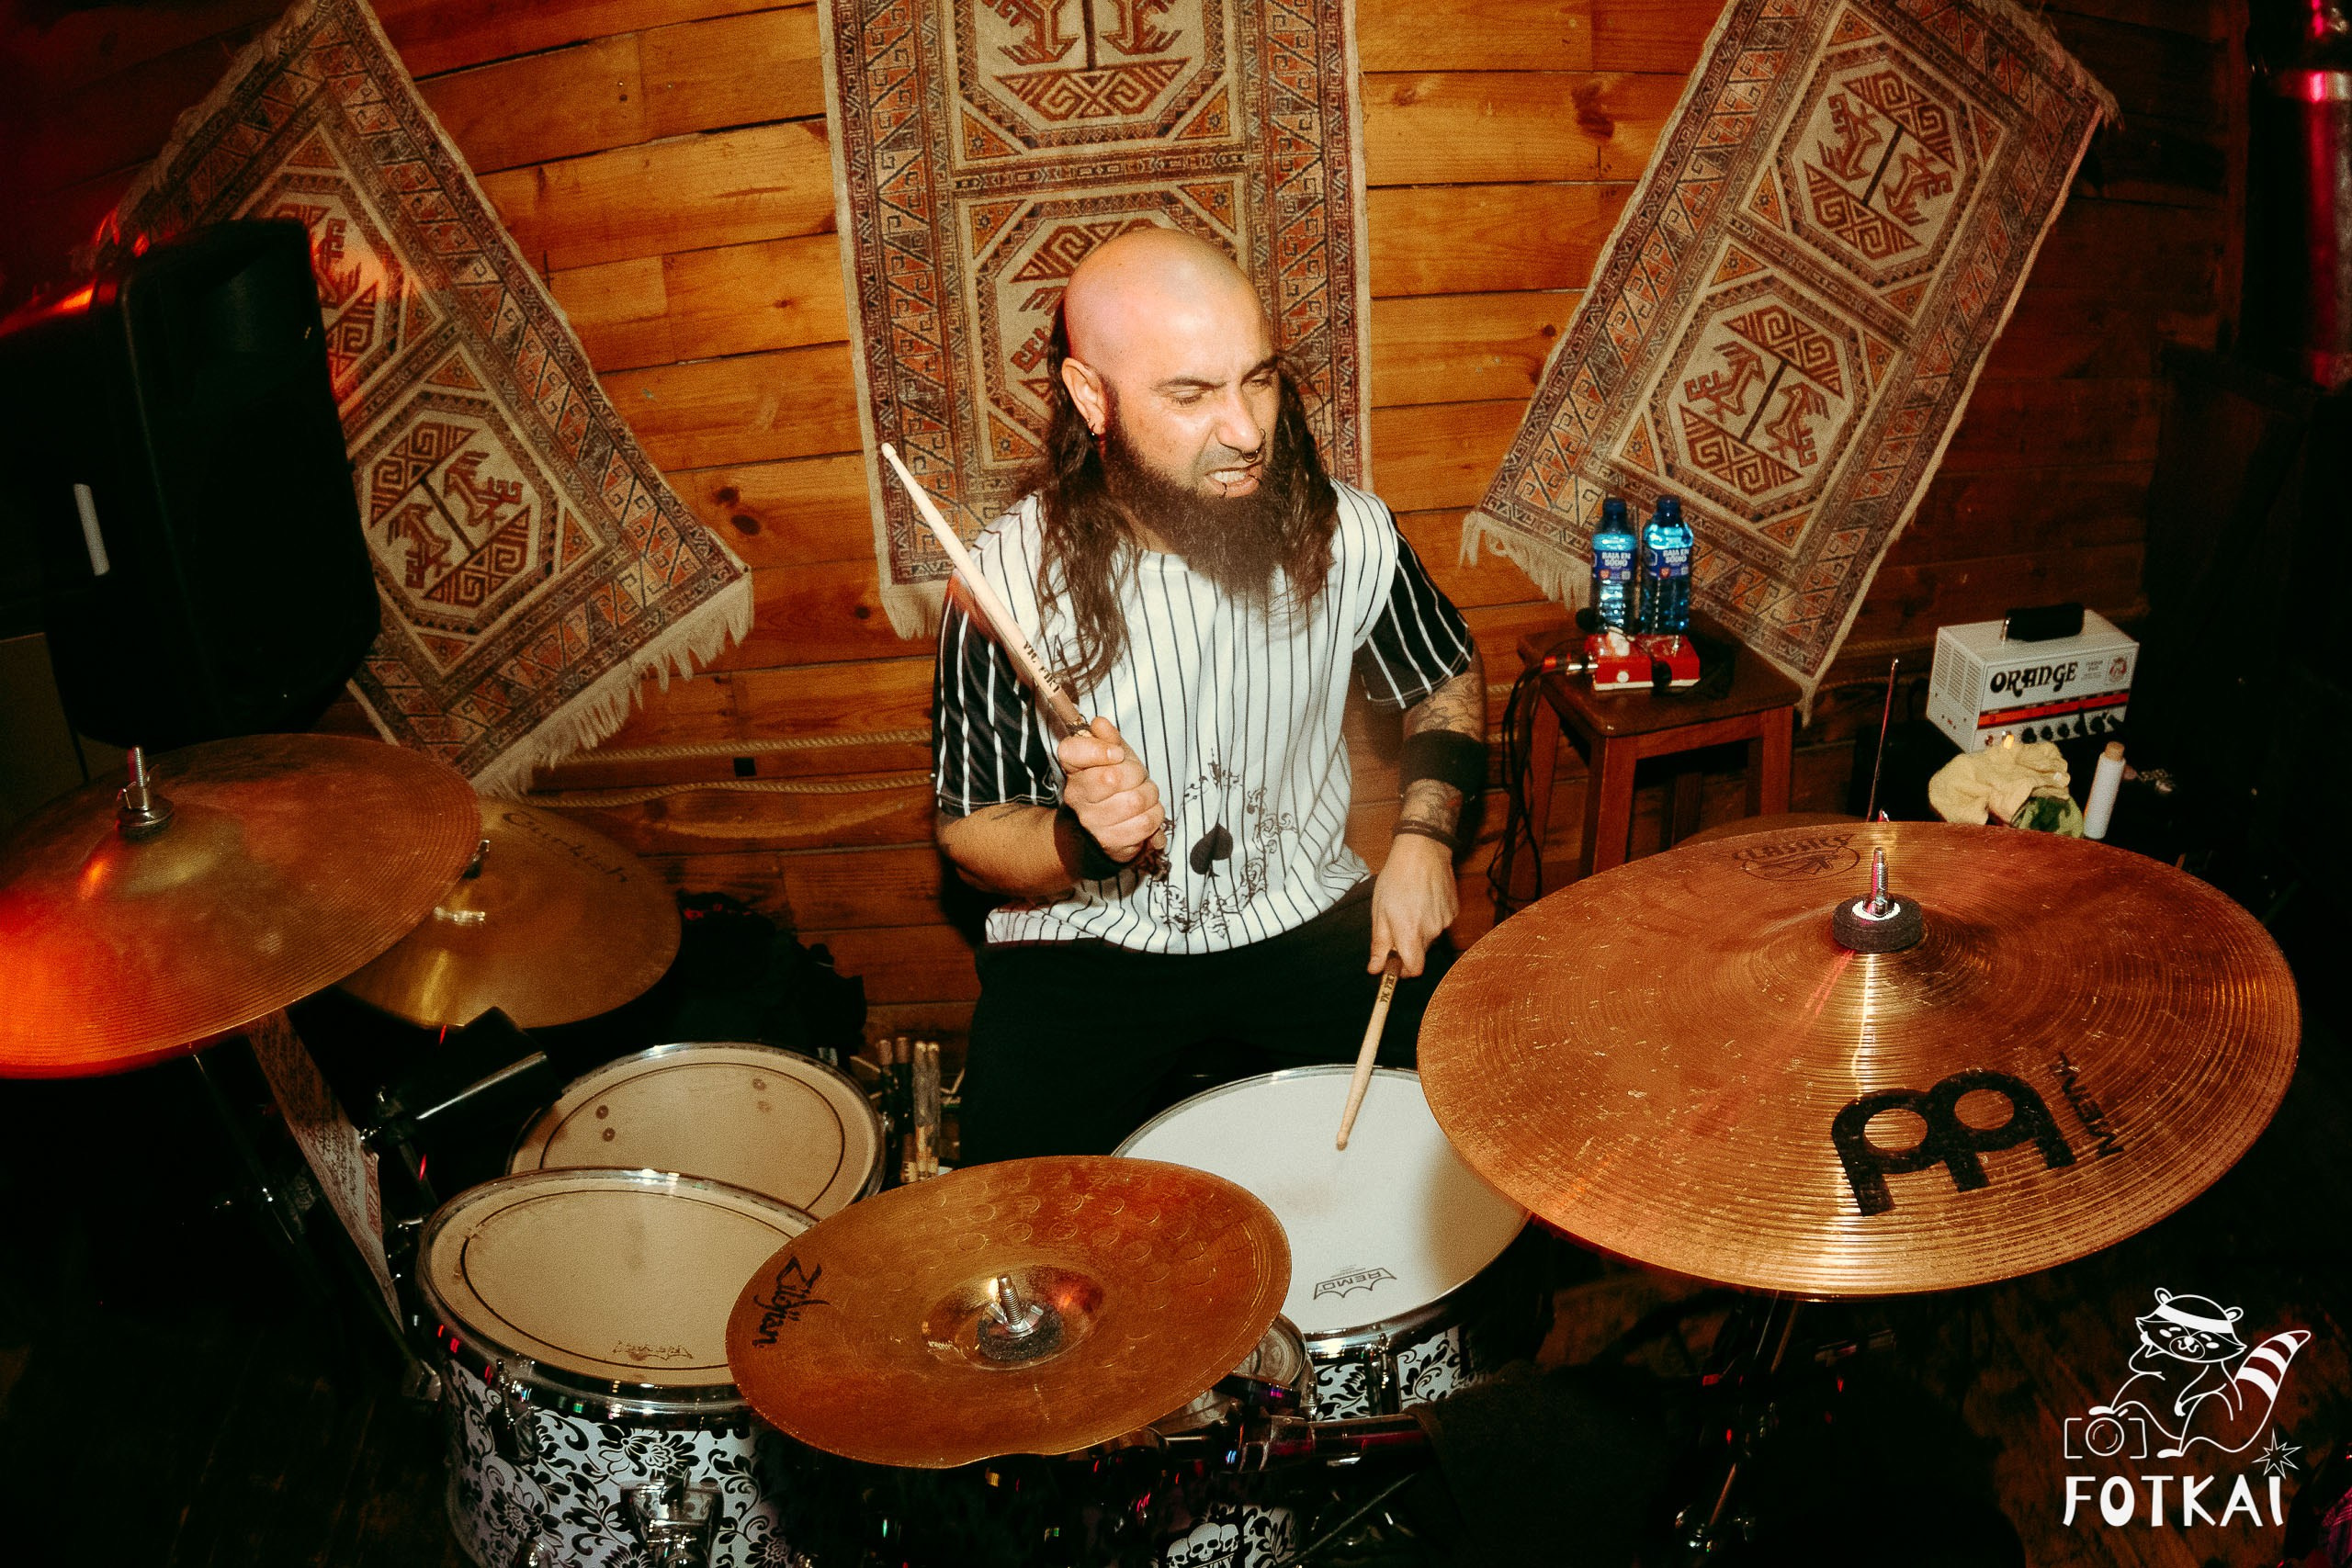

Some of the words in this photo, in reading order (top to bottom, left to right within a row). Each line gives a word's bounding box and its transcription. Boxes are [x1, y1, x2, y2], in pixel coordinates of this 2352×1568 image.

[1990, 661, 2078, 697] ORANGE
[2048, 1051, 2125, 1157] MEINL
[1322, 1270, 1382, 1291] REMO
